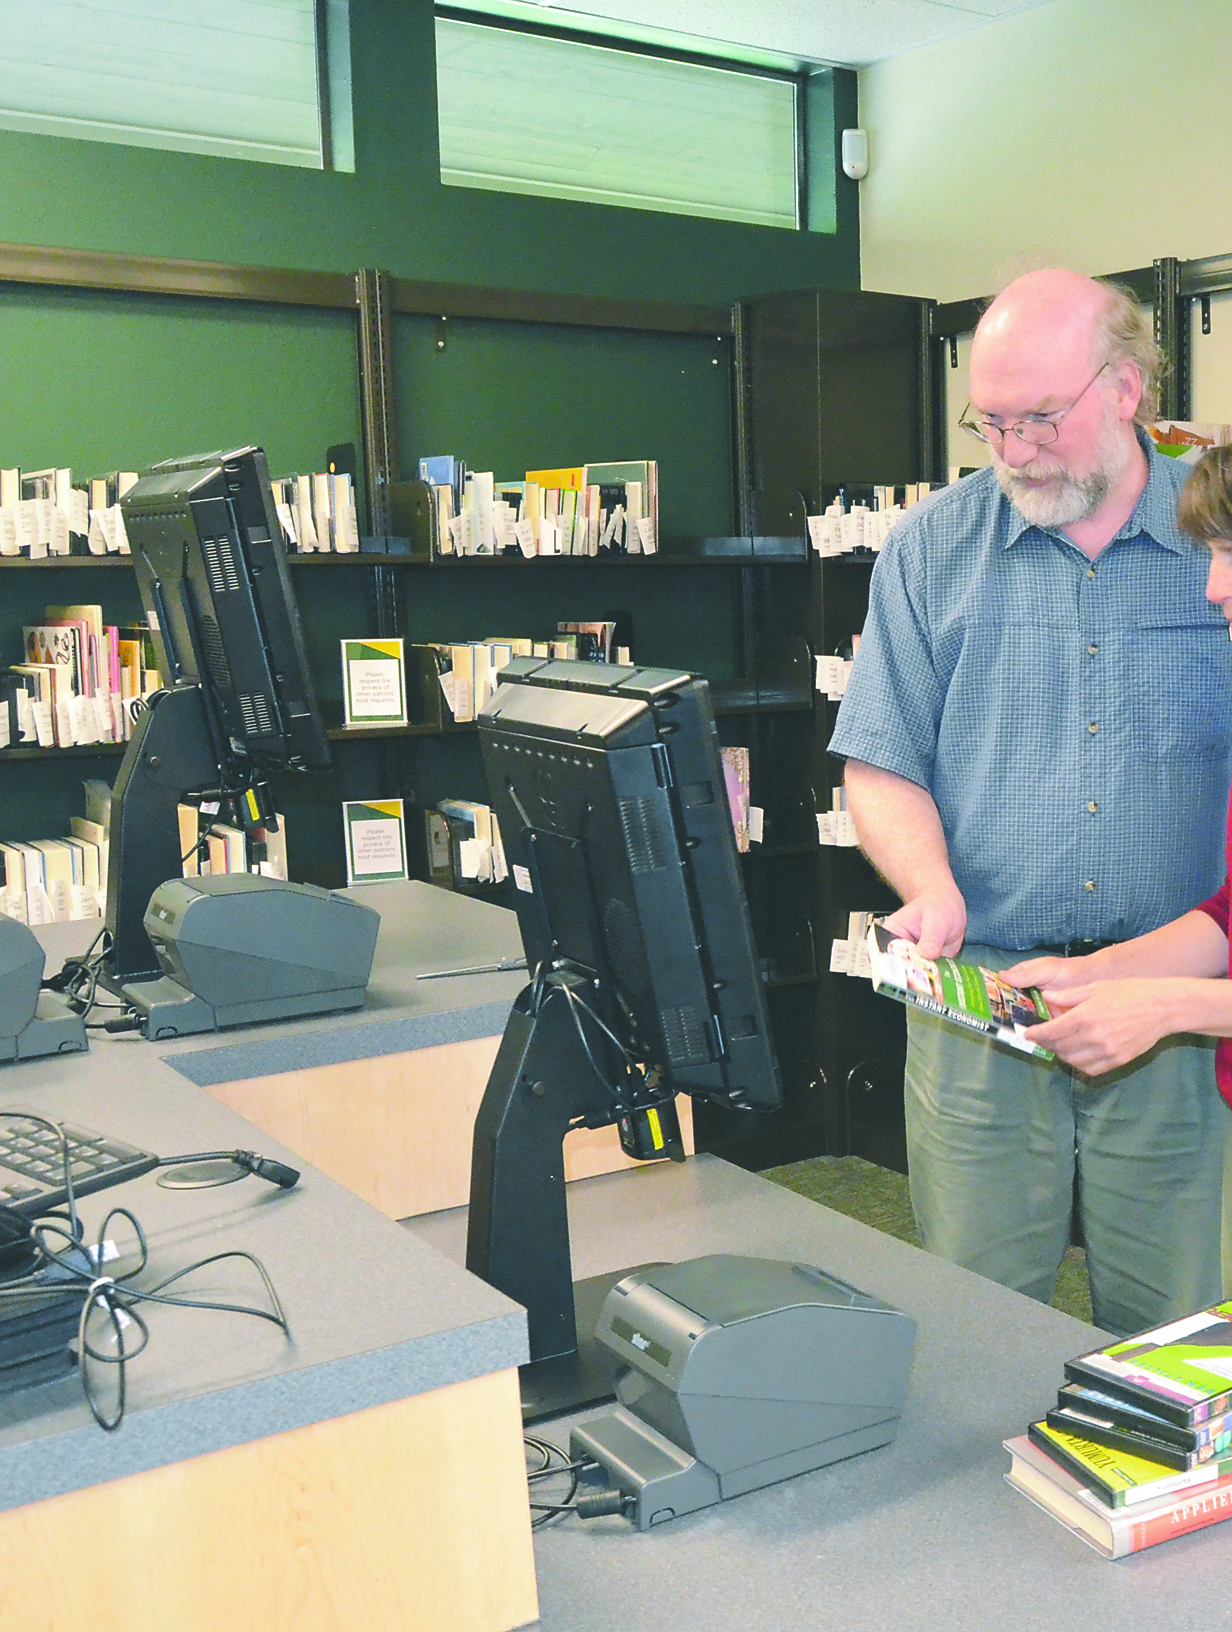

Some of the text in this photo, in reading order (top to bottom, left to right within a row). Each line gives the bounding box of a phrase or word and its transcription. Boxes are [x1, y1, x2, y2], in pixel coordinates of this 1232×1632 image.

[915, 995, 947, 1015] INSTANT
[947, 1008, 990, 1032] ECONOMIST
[1129, 1360, 1183, 1381] STILLER
[1185, 1381, 1216, 1394] BEN
[1157, 1477, 1191, 1491] Yumurta
